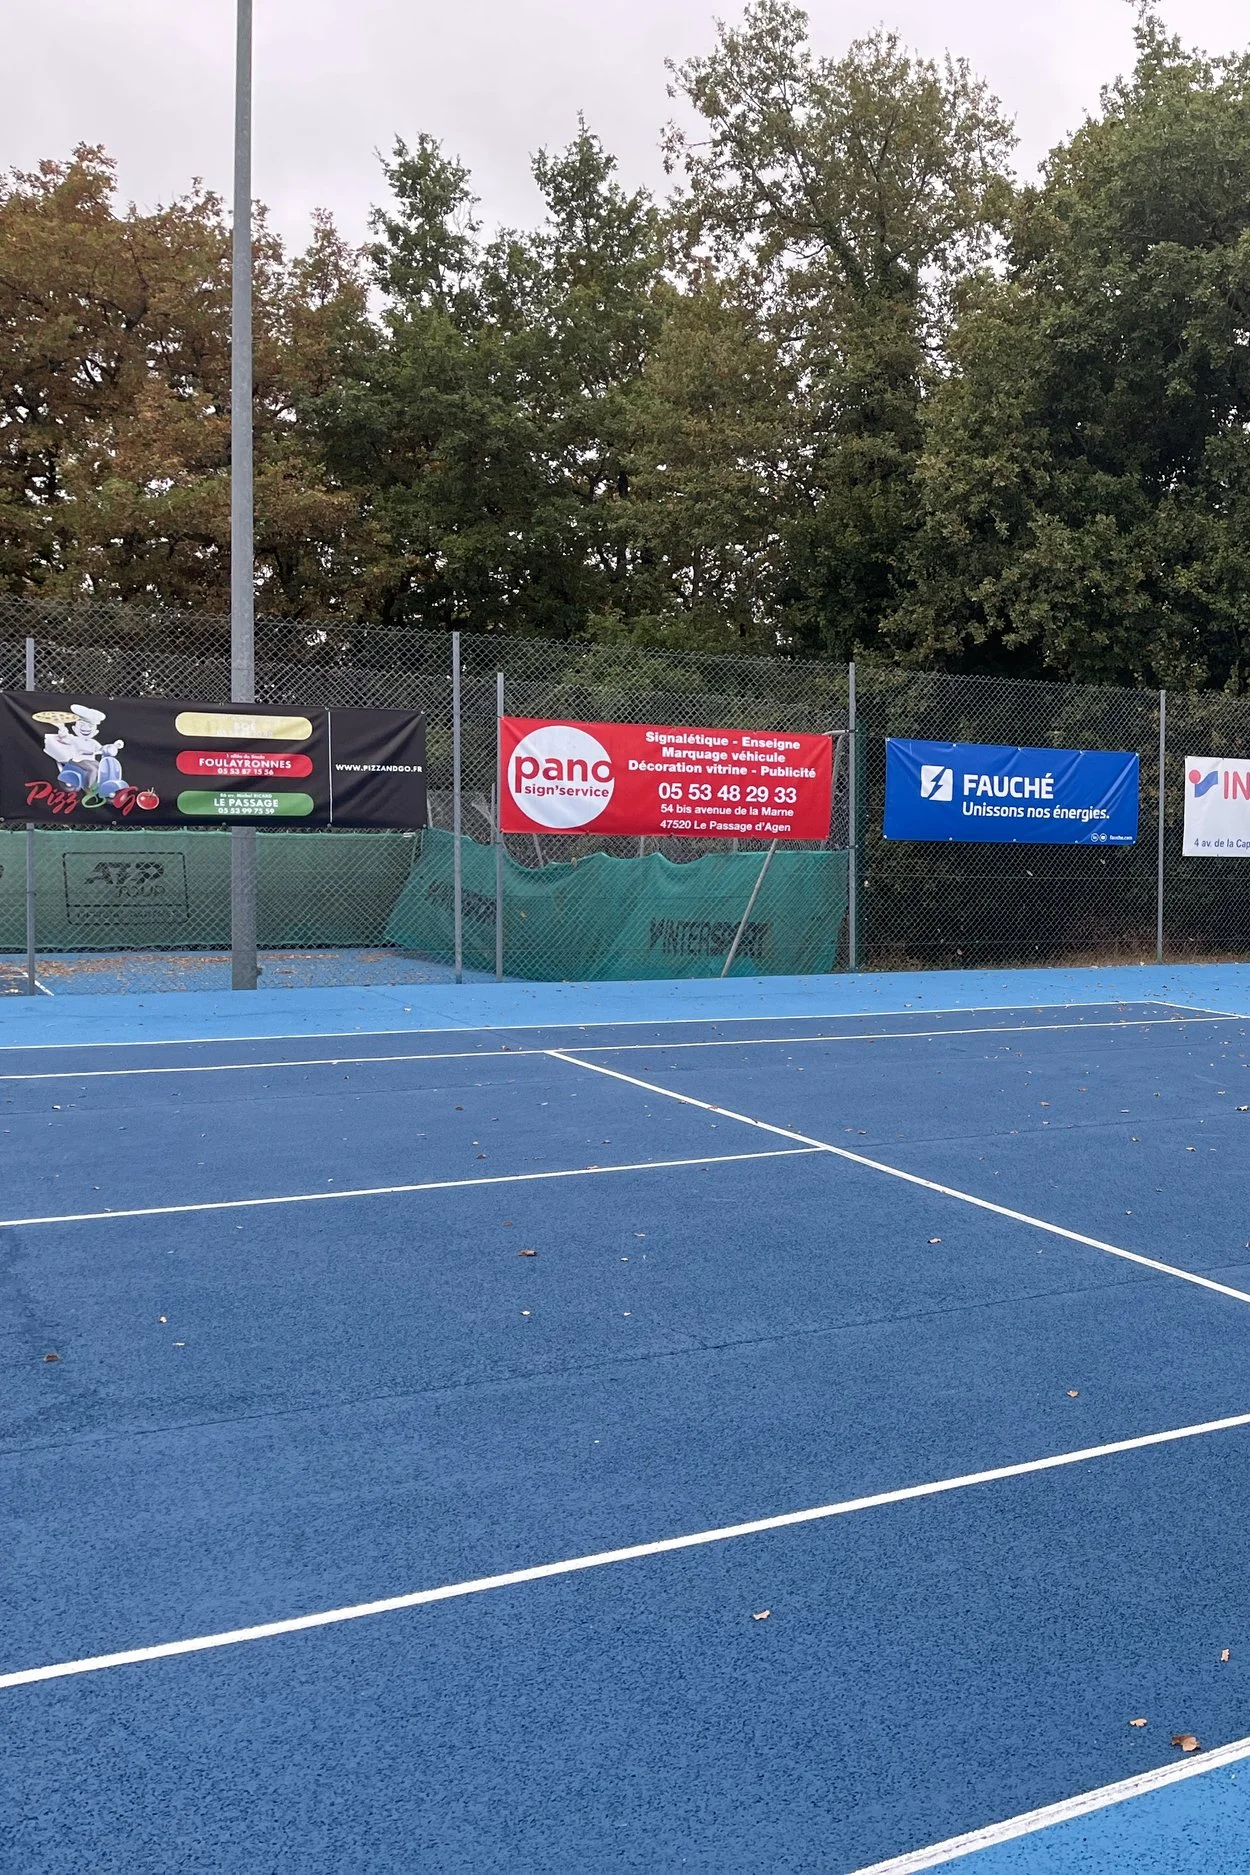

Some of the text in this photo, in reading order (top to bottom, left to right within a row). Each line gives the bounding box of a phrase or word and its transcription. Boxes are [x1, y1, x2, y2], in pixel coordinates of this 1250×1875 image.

[645, 731, 729, 747] Signalétique
[742, 736, 801, 750] Enseigne
[662, 747, 786, 763] Marquage véhicule
[199, 758, 292, 769] FOULAYRONNES
[335, 764, 423, 773] WWW.PIZZANDGO.FR
[628, 760, 702, 774] Décoration
[706, 763, 748, 776] vitrine
[760, 765, 817, 779] Publicité
[515, 756, 616, 793] pano
[524, 784, 609, 797] sign'service
[658, 782, 797, 804] 05 53 48 29 33
[963, 773, 1054, 799] FAUCHÉ
[214, 798, 279, 808] LE PASSAGE
[660, 804, 794, 817] 54 bis avenue de la Marne
[218, 807, 229, 815] 05
[963, 801, 1110, 822] Unissons nos énergies.
[660, 820, 791, 834] 47520 Le Passage d'Agen
[1194, 838, 1199, 847] 4
[1214, 838, 1225, 848] de
[1226, 838, 1234, 848] la
[84, 861, 164, 885] ATP
